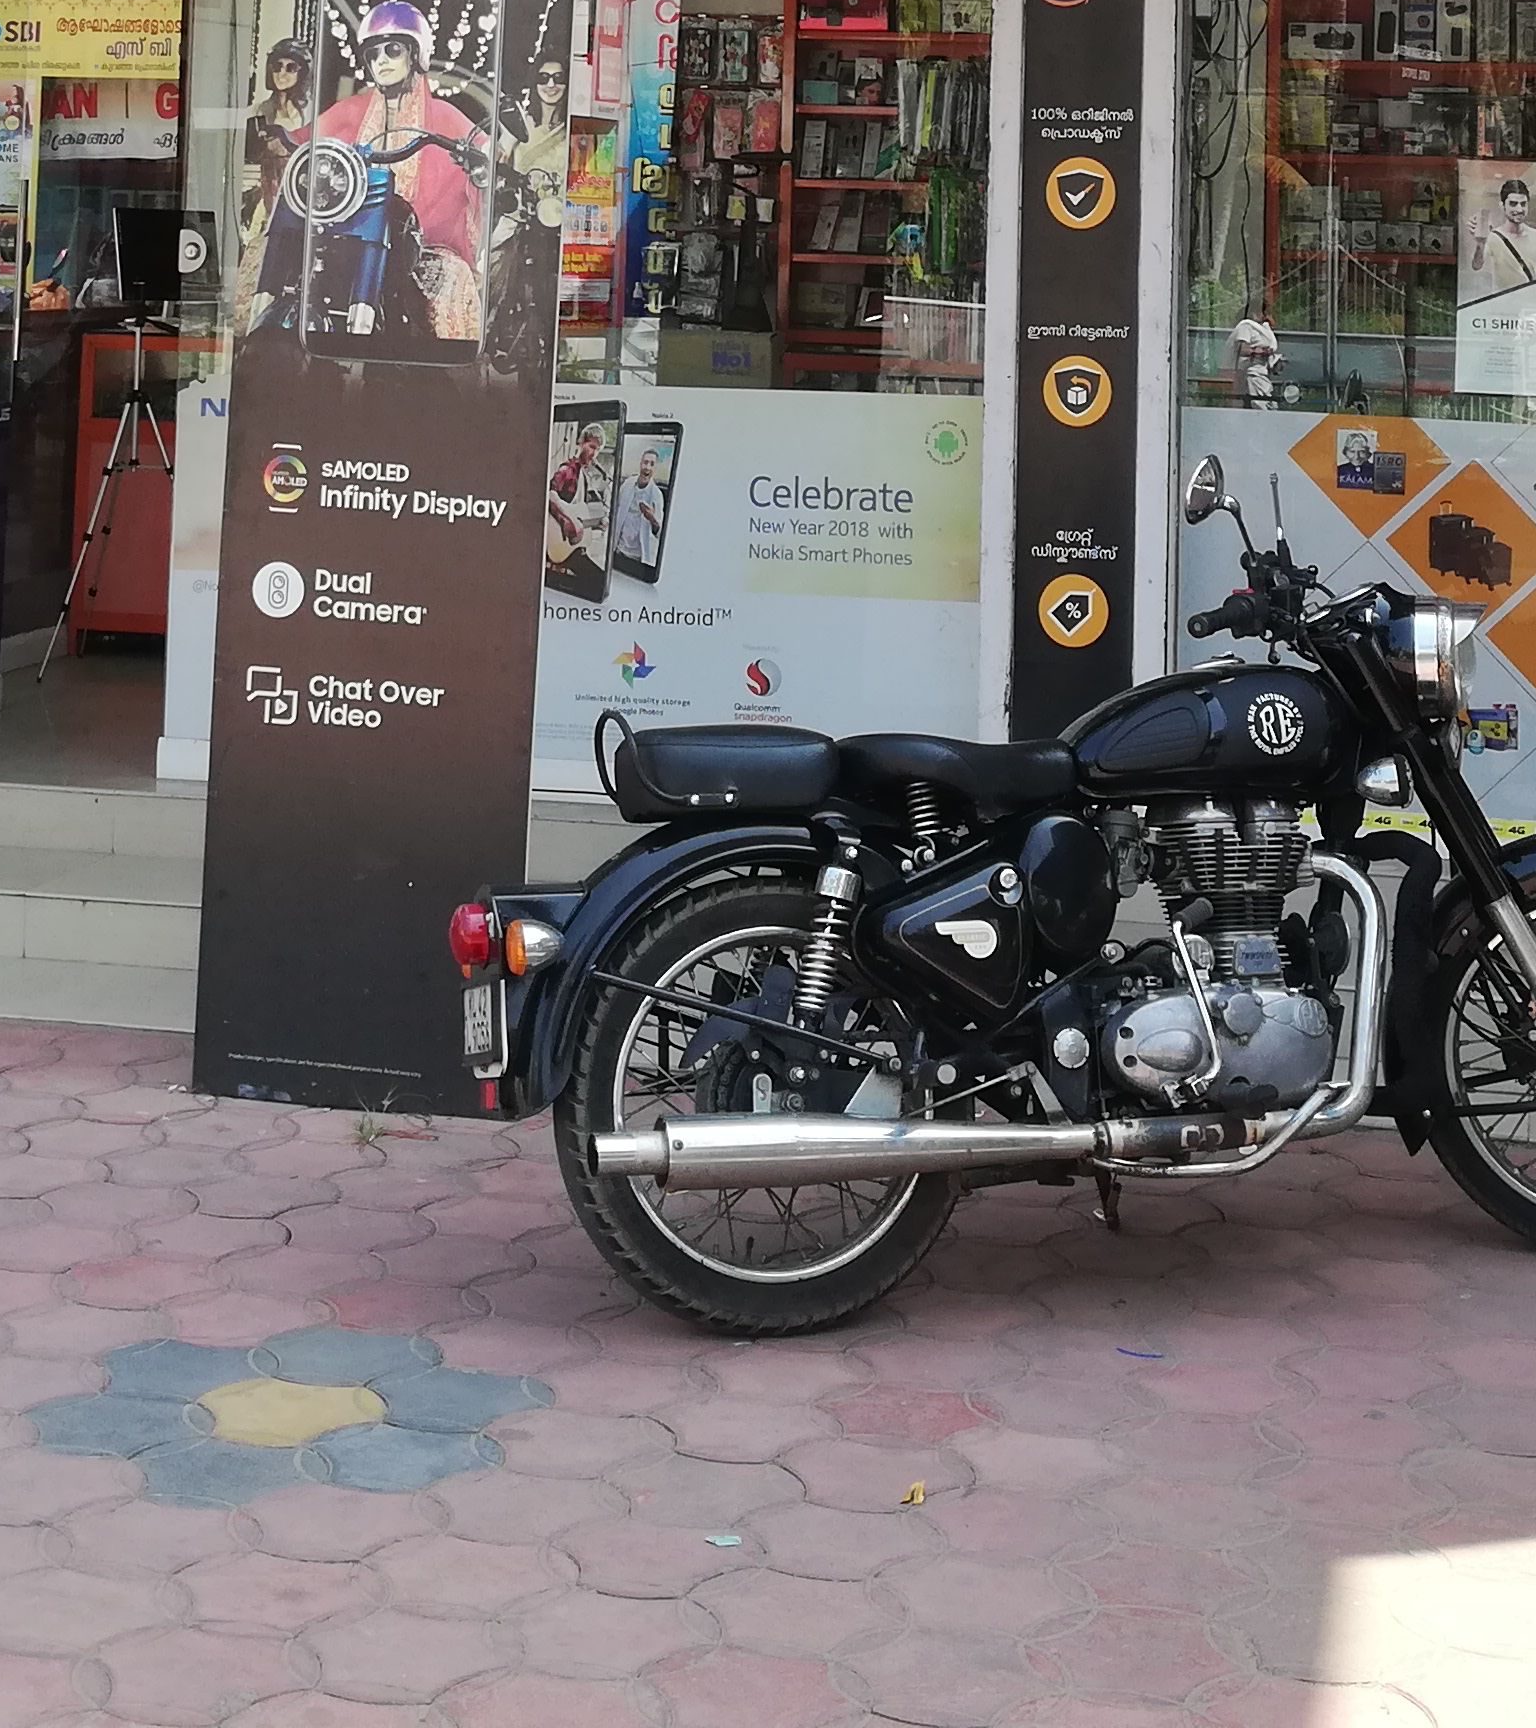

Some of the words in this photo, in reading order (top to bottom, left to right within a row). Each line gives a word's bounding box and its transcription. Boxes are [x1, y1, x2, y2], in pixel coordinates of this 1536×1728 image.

[5, 21, 41, 43] SBI
[1030, 107, 1068, 121] 100%
[1472, 318, 1486, 328] C1
[1492, 319, 1535, 330] SHINE
[321, 459, 410, 483] sAMOLED
[319, 484, 408, 520] Infinity
[412, 490, 507, 527] Display
[748, 475, 914, 513] Celebrate
[749, 518, 785, 535] New
[789, 519, 825, 536] Year
[828, 520, 870, 537] 2018
[878, 522, 914, 540] with
[748, 544, 795, 562] Nokia
[798, 545, 848, 564] Smart
[852, 547, 913, 566] Phones
[314, 568, 372, 595] Dual
[542, 601, 602, 623] hones
[608, 606, 632, 623] on
[308, 675, 373, 701] Chat
[378, 681, 445, 707] Over
[307, 700, 382, 729] Video
[734, 712, 793, 723] snapdragon
[1259, 702, 1296, 744] RE
